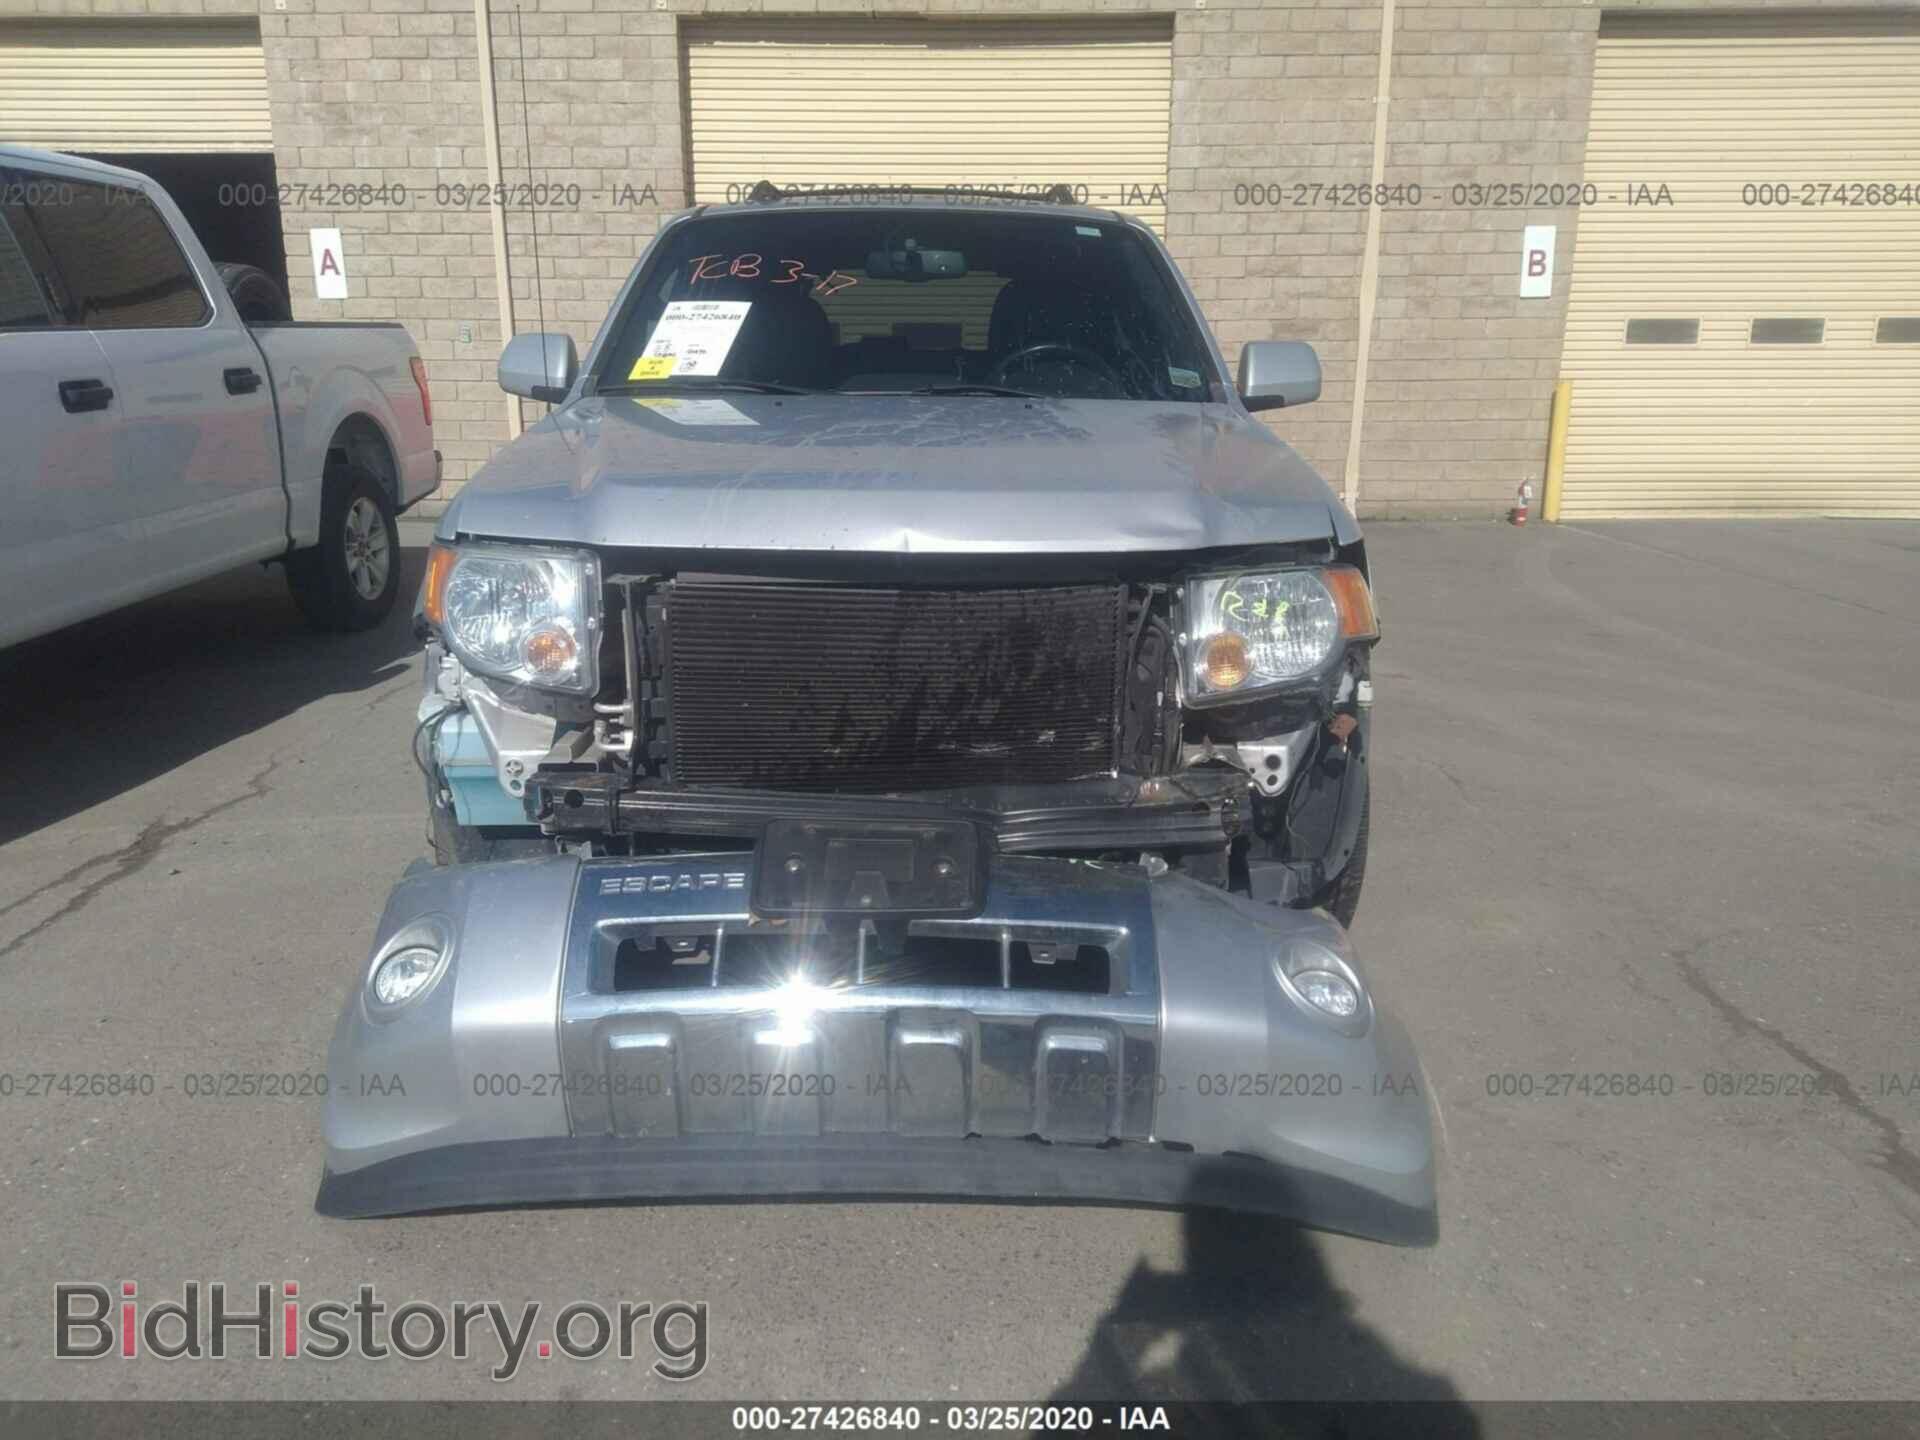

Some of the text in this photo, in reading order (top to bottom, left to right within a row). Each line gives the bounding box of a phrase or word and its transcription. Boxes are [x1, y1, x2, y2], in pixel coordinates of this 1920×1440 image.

[320, 248, 340, 276] A
[1528, 249, 1547, 277] B
[600, 872, 746, 896] ESCAPE
